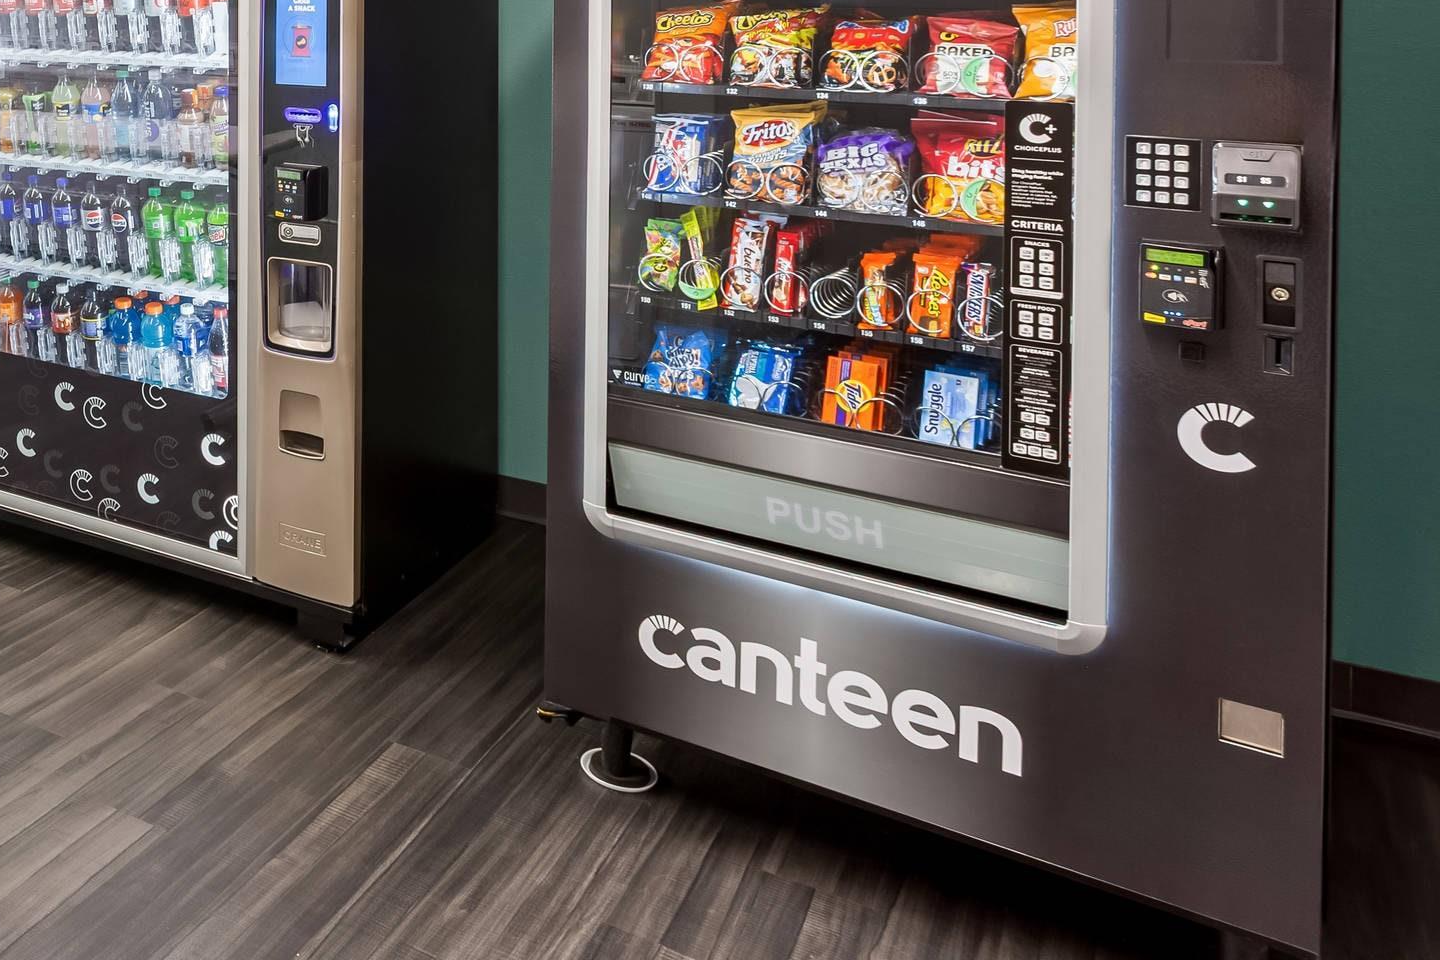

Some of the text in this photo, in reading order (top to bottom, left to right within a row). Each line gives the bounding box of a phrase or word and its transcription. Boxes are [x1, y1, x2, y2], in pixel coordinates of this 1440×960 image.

[656, 11, 711, 33] Cheetos
[936, 46, 994, 59] BAKED
[743, 121, 795, 144] Fritos
[826, 143, 878, 161] BIG
[1013, 145, 1063, 154] CHOICEPLUS
[819, 153, 887, 171] TEXAS
[947, 155, 1005, 182] bits
[1236, 175, 1273, 185] $1 $5
[1011, 220, 1064, 232] CRITERIA
[743, 247, 756, 284] bueno
[929, 268, 950, 317] Reese's
[965, 271, 986, 324] SNICKERS
[681, 302, 692, 310] 151
[723, 309, 735, 317] 152
[813, 322, 826, 330] 154
[961, 344, 975, 352] 157
[1018, 347, 1054, 357] BEVERAGES
[623, 371, 650, 384] curve
[844, 383, 862, 410] Tide
[924, 383, 945, 435] Snuggle
[765, 497, 884, 549] PUSH
[638, 614, 1024, 778] canteen
